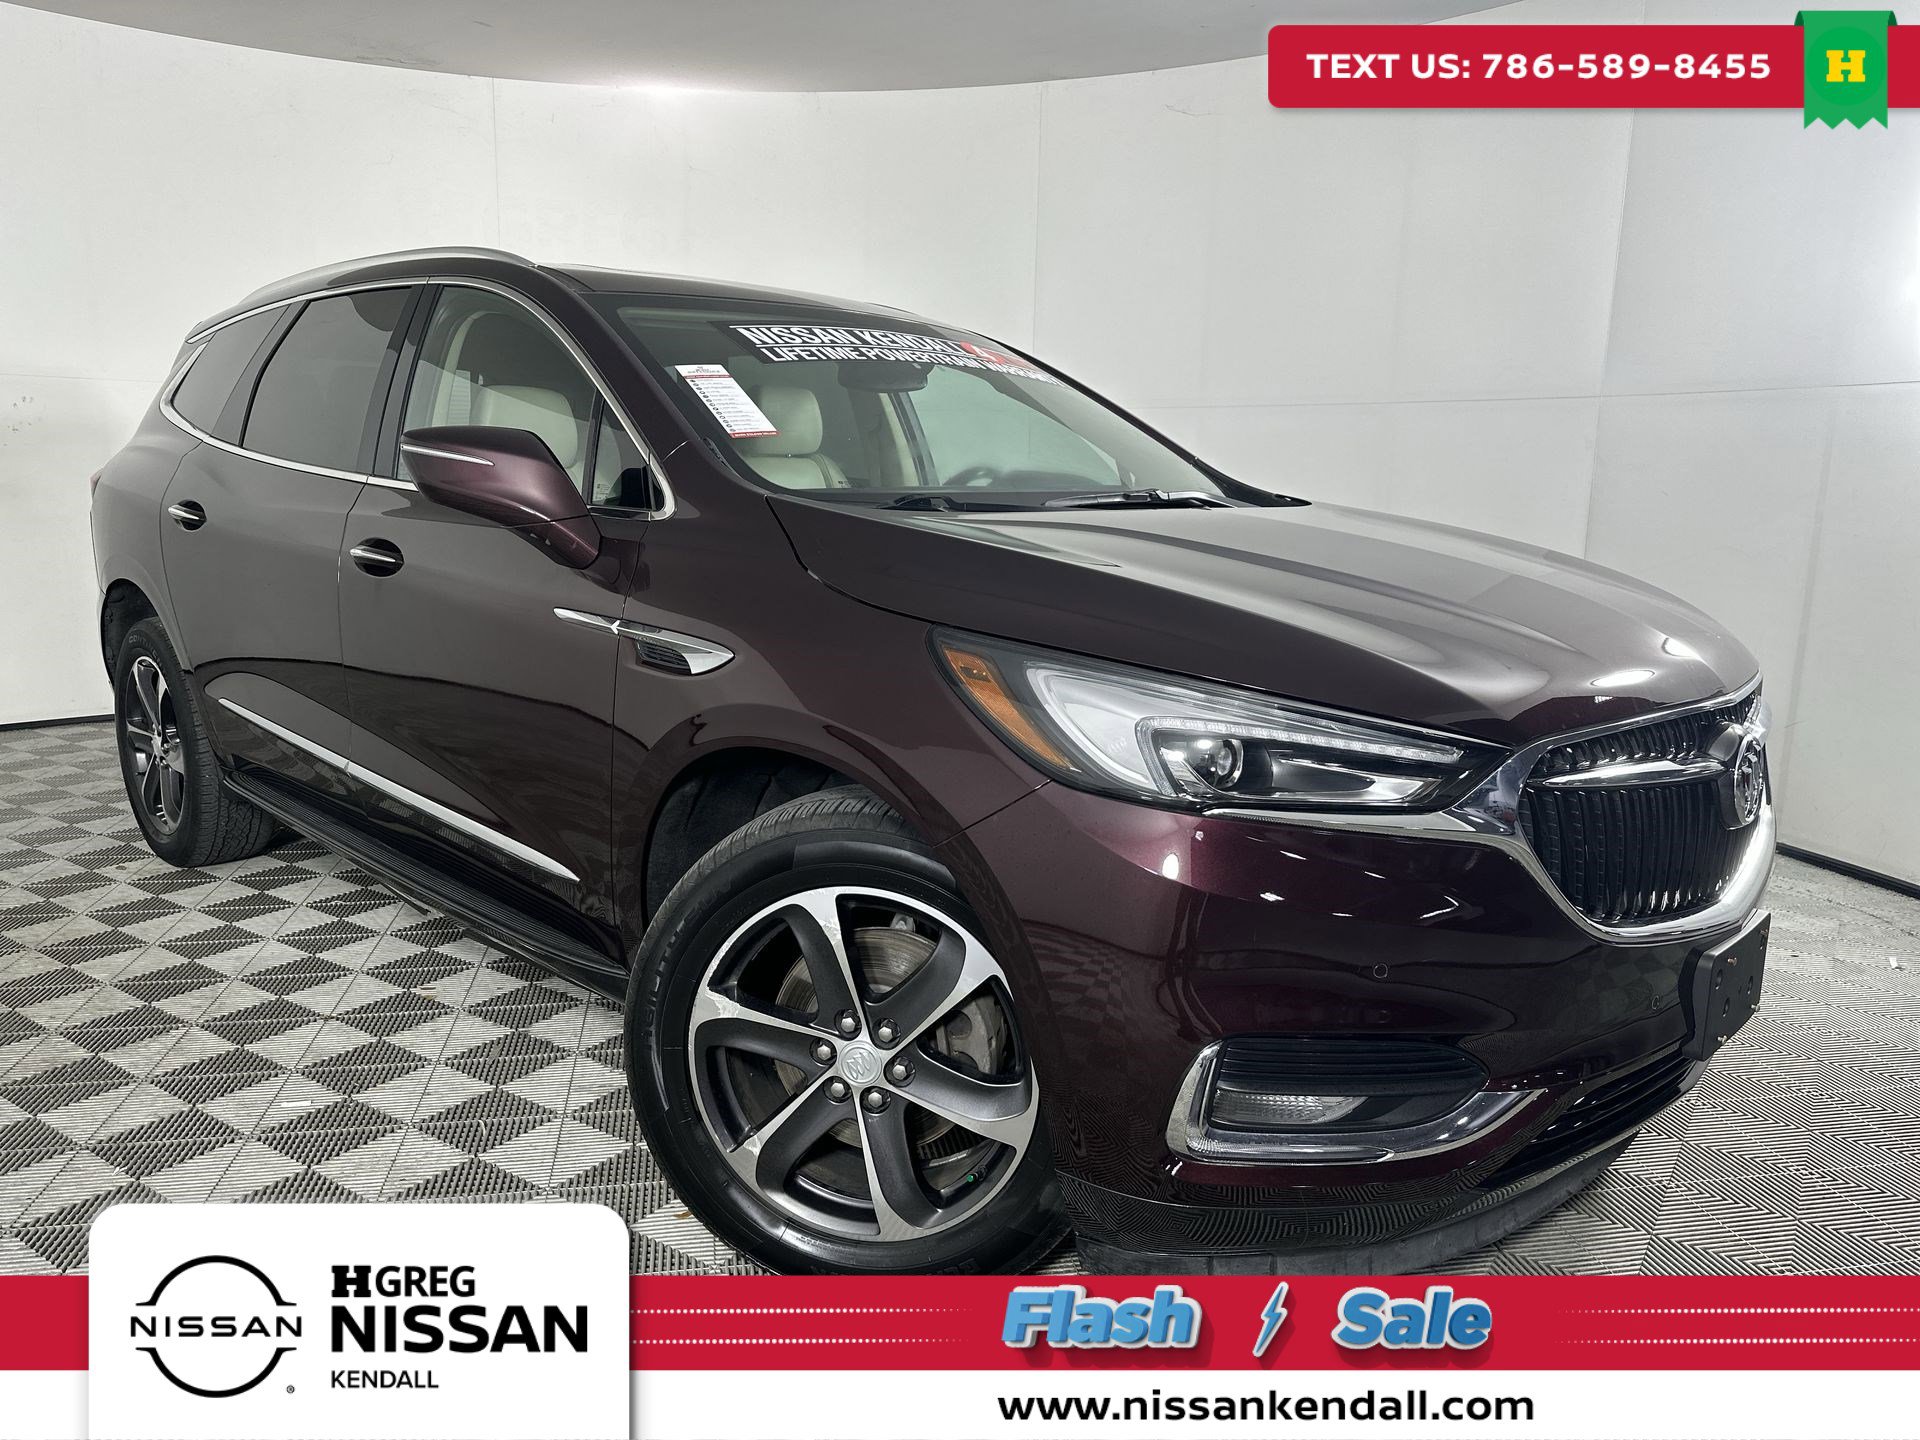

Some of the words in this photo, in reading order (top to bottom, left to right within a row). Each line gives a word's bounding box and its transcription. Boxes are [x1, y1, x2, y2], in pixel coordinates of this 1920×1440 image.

[735, 327, 862, 345] NISSAN
[853, 330, 970, 357] KENDALL
[759, 346, 868, 362] LIFETIME
[858, 347, 987, 370] POWERTRAIN
